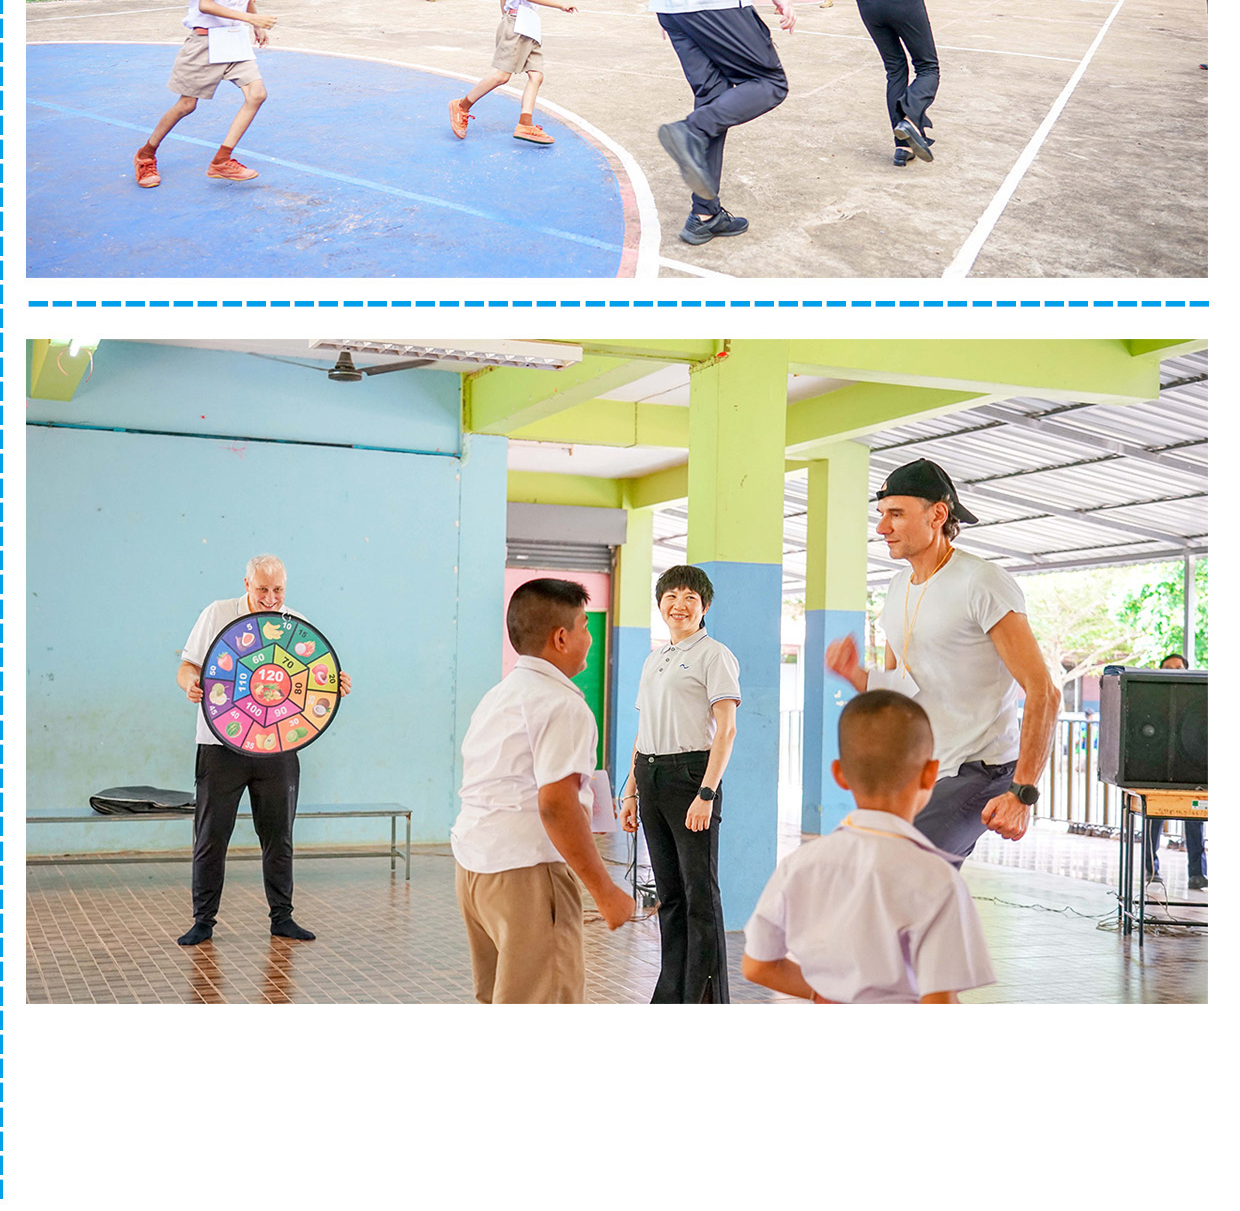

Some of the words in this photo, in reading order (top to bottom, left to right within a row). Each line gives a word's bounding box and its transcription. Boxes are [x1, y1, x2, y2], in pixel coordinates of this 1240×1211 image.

[247, 623, 253, 631] 5
[282, 622, 292, 630] 10
[298, 629, 308, 638] 15
[252, 653, 265, 664] 60
[282, 657, 294, 669] 70
[210, 665, 217, 676] 50
[259, 669, 284, 682] 120
[239, 673, 248, 692] 110
[328, 674, 336, 684] 20
[294, 682, 302, 695] 80
[246, 701, 262, 717] 100
[274, 706, 288, 717] 90
[230, 711, 240, 719] 40
[289, 718, 300, 727] 30
[245, 741, 255, 749] 35
